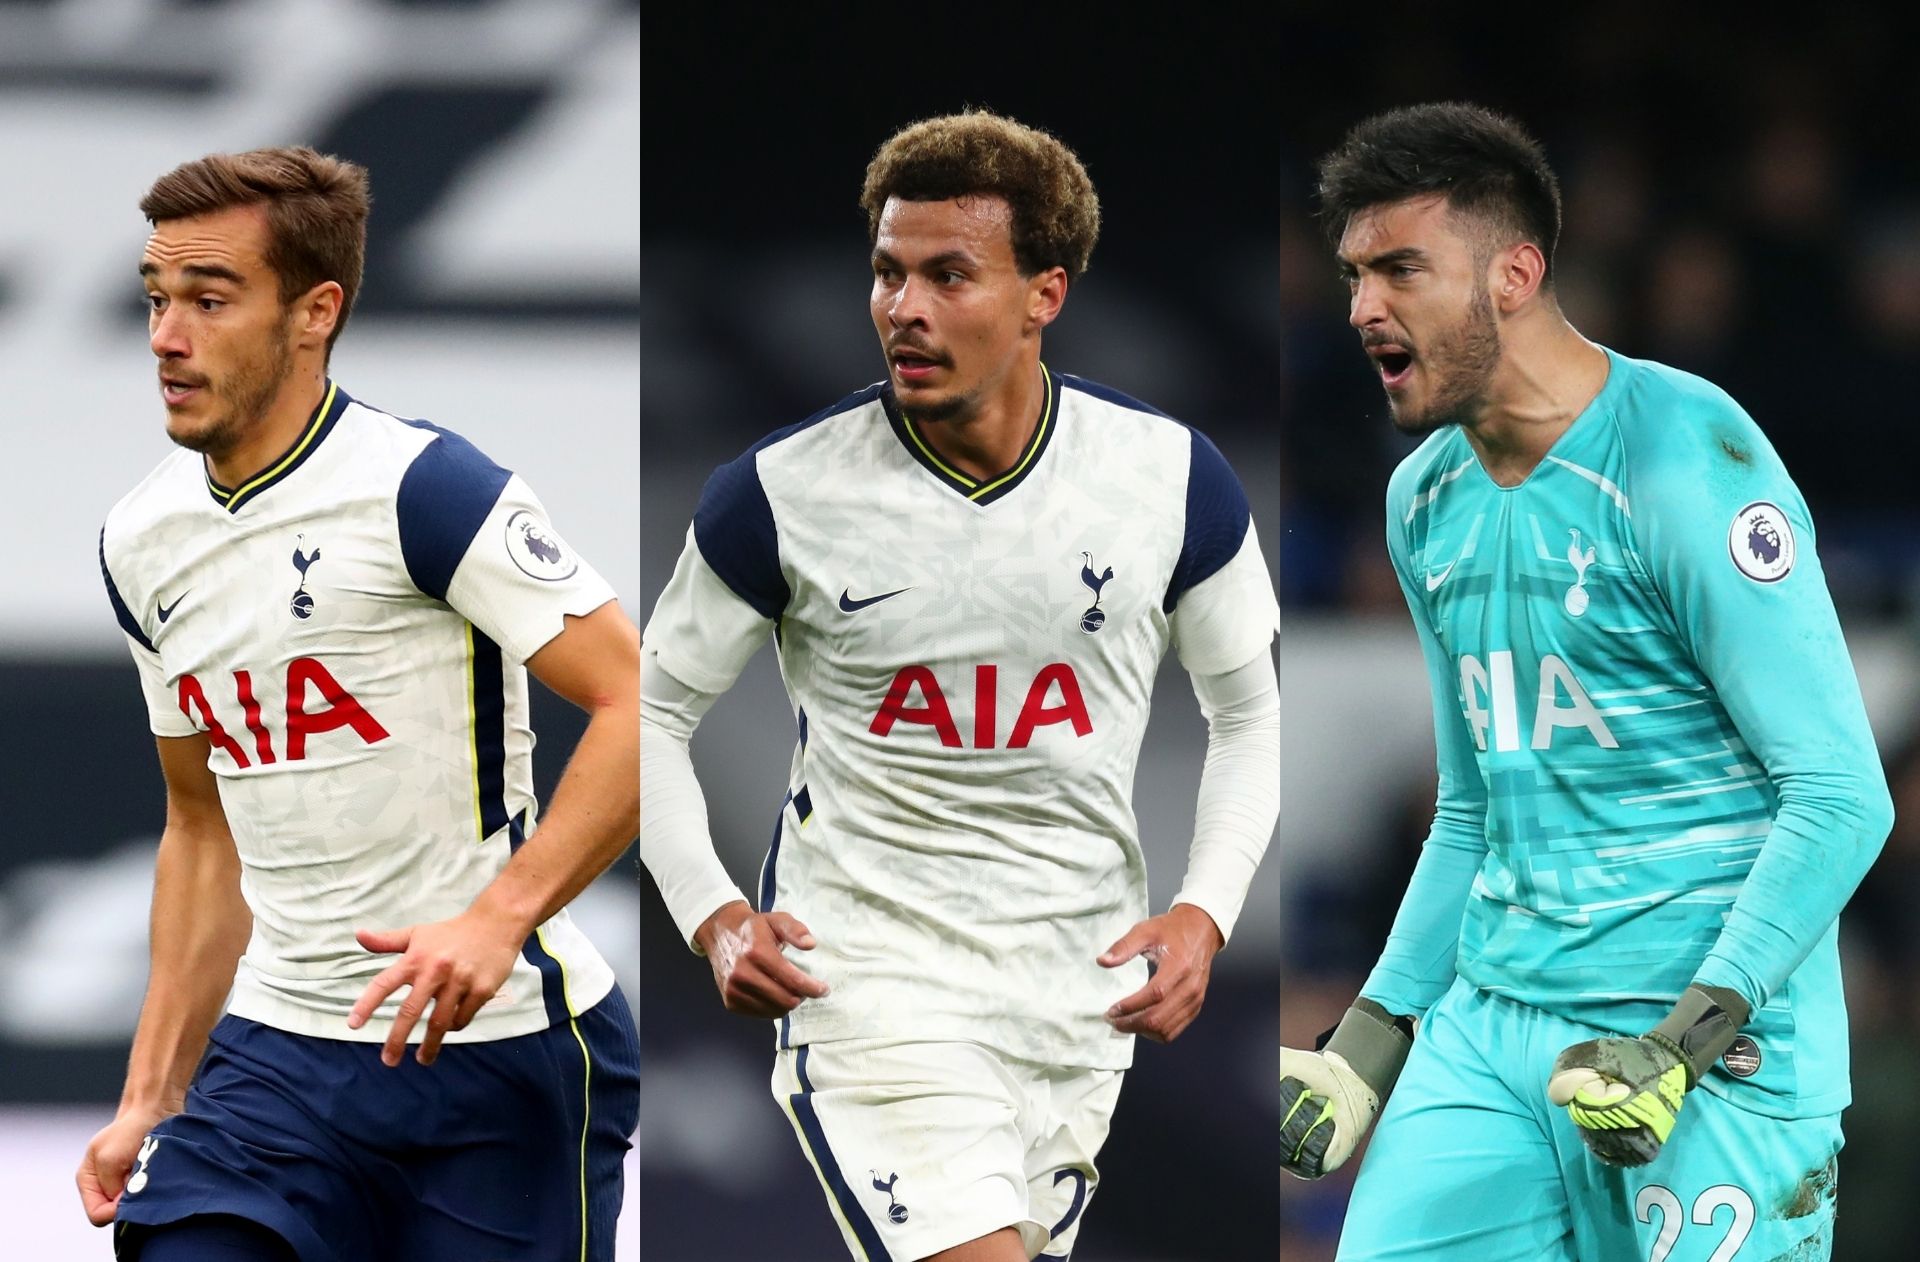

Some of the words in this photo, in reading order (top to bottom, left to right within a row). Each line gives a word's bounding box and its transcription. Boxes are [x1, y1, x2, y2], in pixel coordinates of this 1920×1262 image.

[178, 657, 391, 770] AIA
[868, 662, 1094, 749] AIA
[1460, 650, 1620, 753] AIA
[1634, 1184, 1756, 1262] 22
